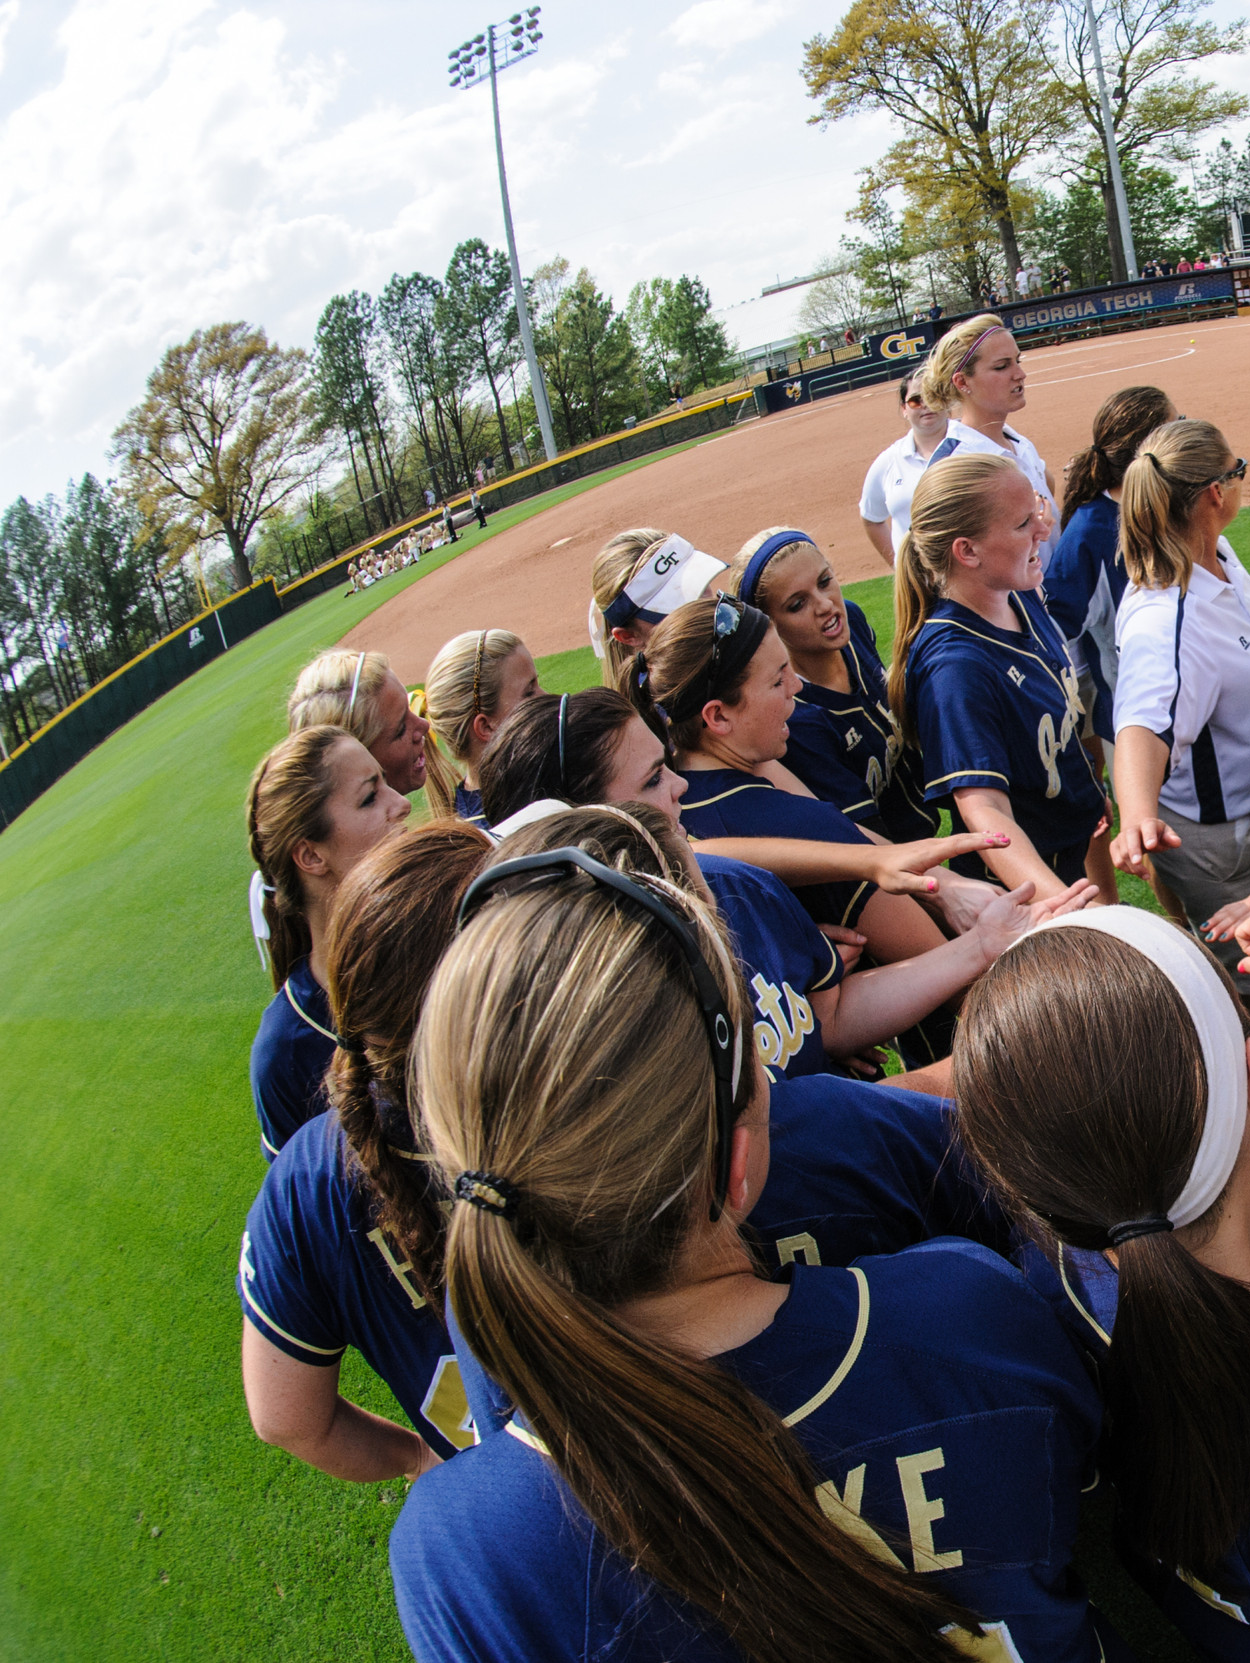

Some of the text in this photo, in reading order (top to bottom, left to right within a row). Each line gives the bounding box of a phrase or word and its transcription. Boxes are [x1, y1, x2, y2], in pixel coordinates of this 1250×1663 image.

[1012, 300, 1097, 329] GEORGIA
[1102, 291, 1153, 312] TECH
[880, 331, 926, 360] GT
[654, 551, 680, 576] GT
